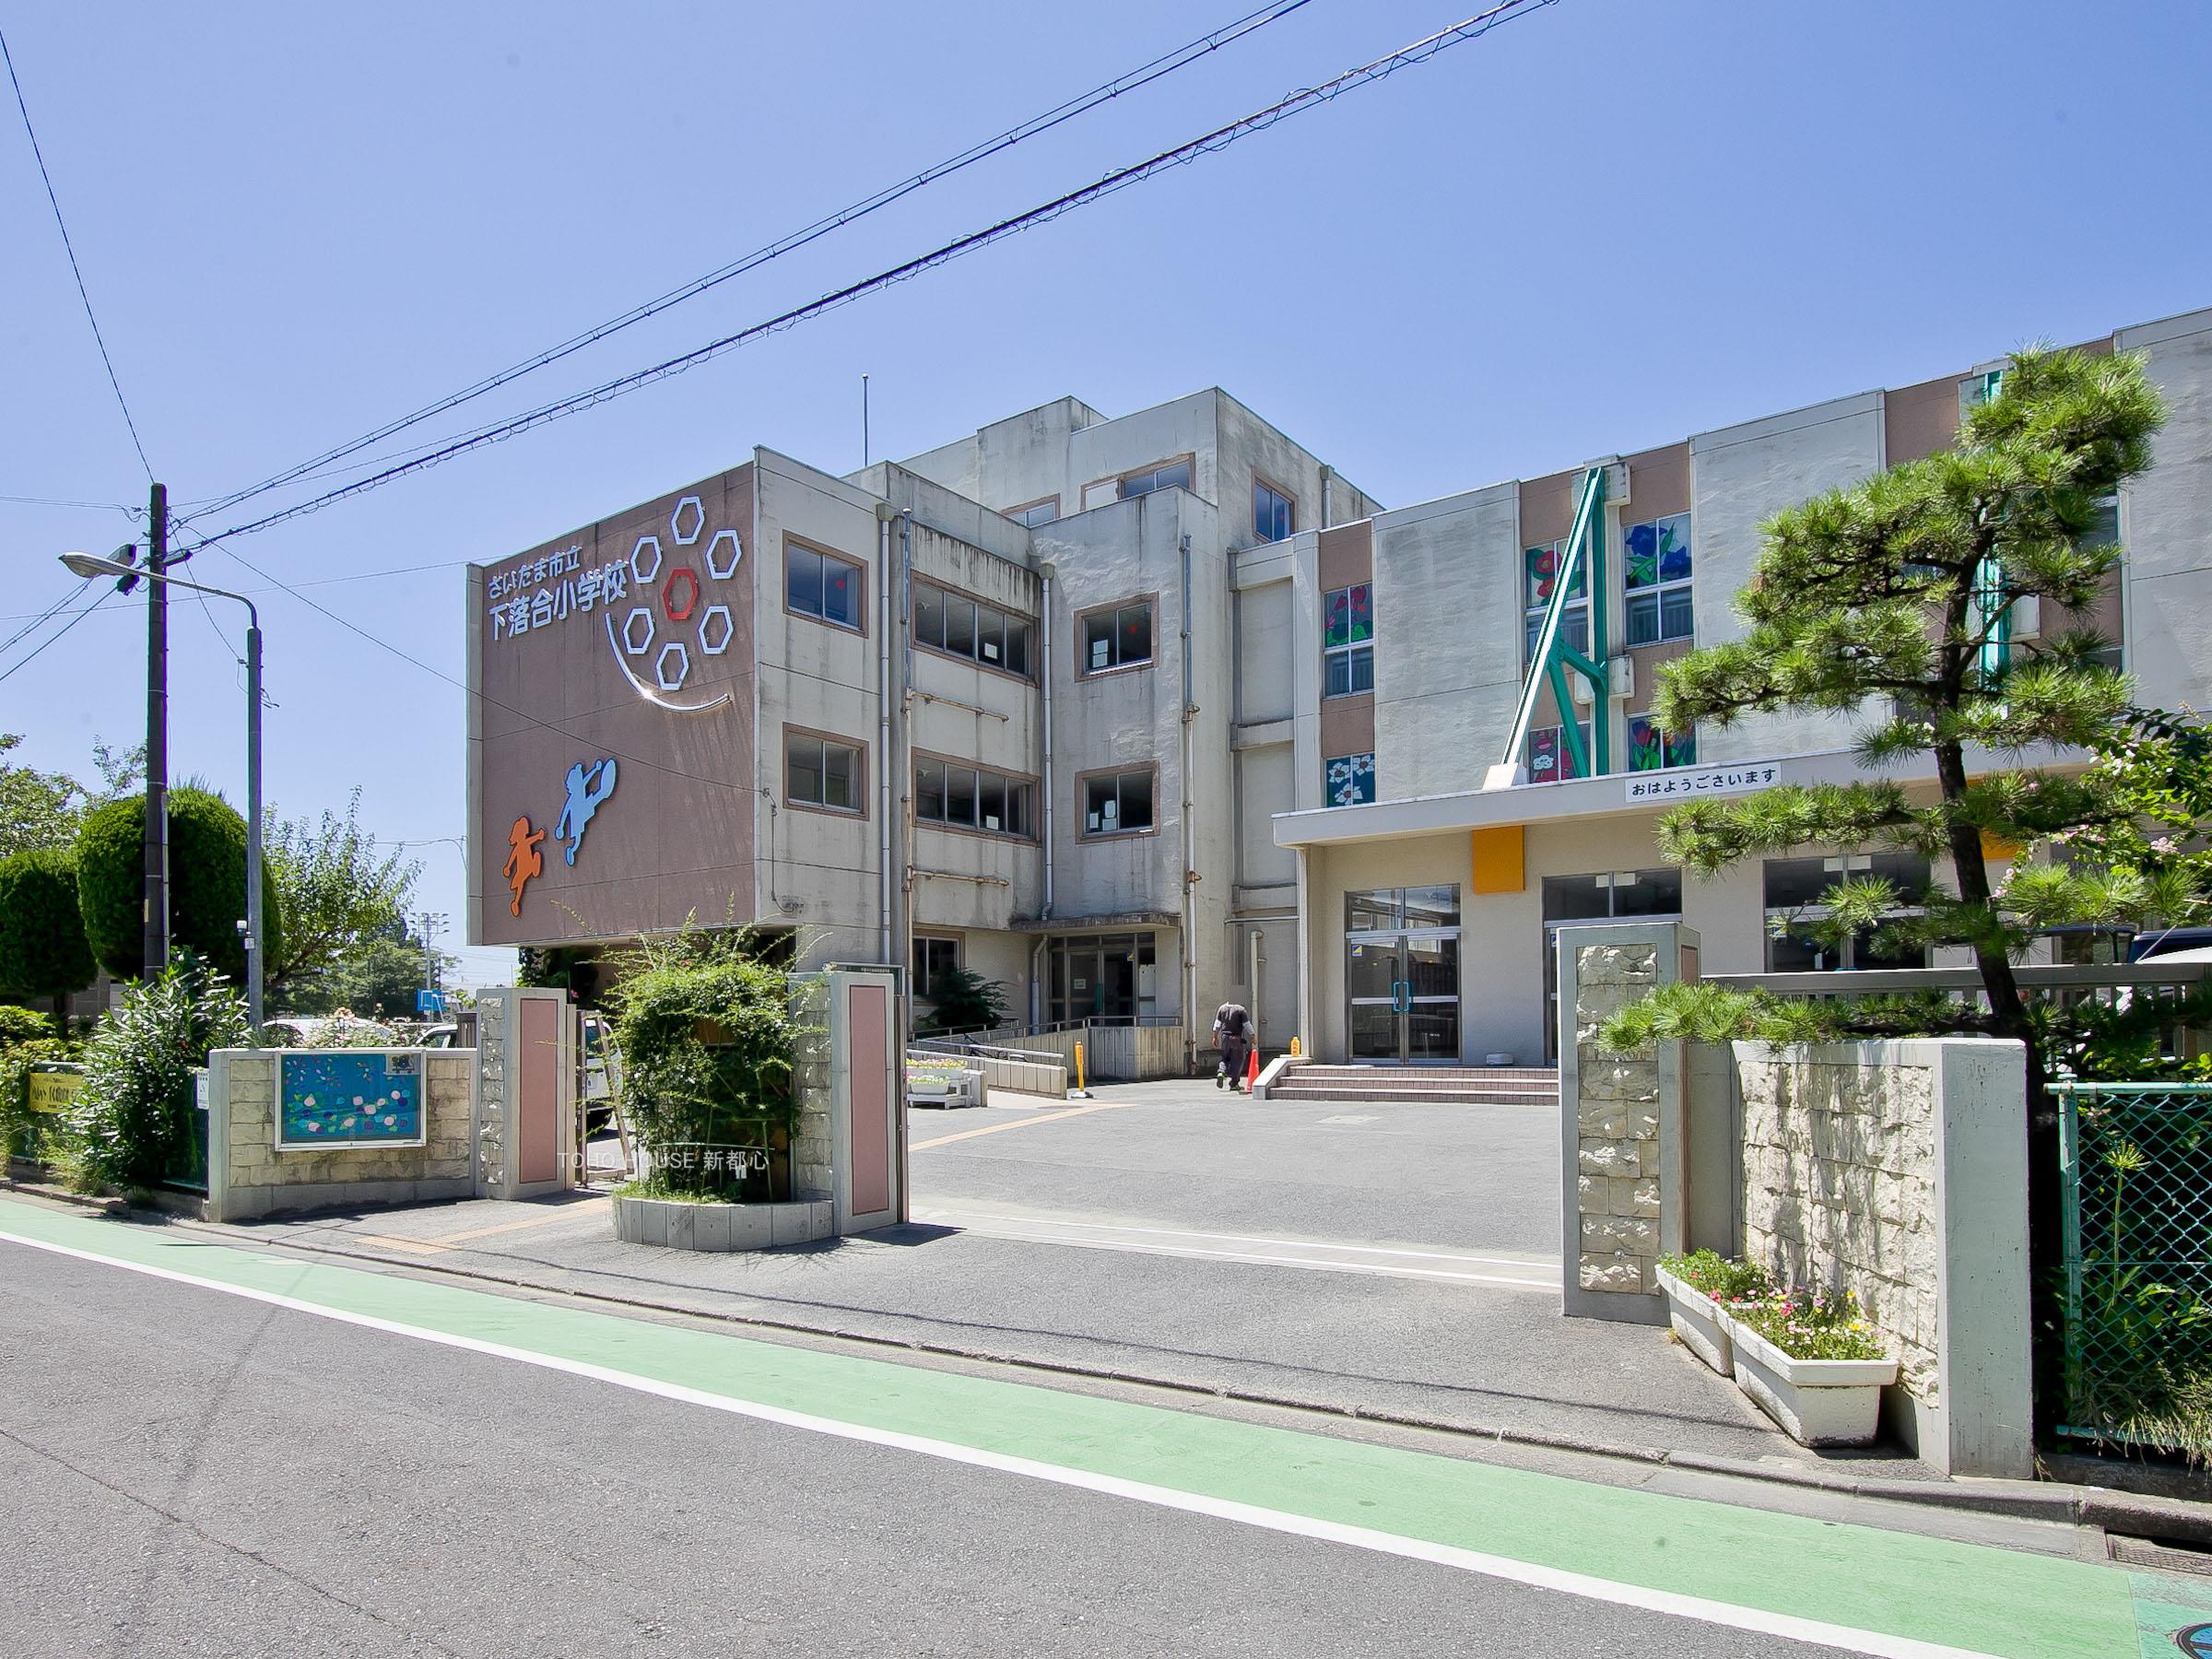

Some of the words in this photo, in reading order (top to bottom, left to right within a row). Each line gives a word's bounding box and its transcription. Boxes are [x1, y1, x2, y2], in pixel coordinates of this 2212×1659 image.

[488, 545, 582, 600] さいたま市立
[488, 559, 629, 641] 下落合小学校
